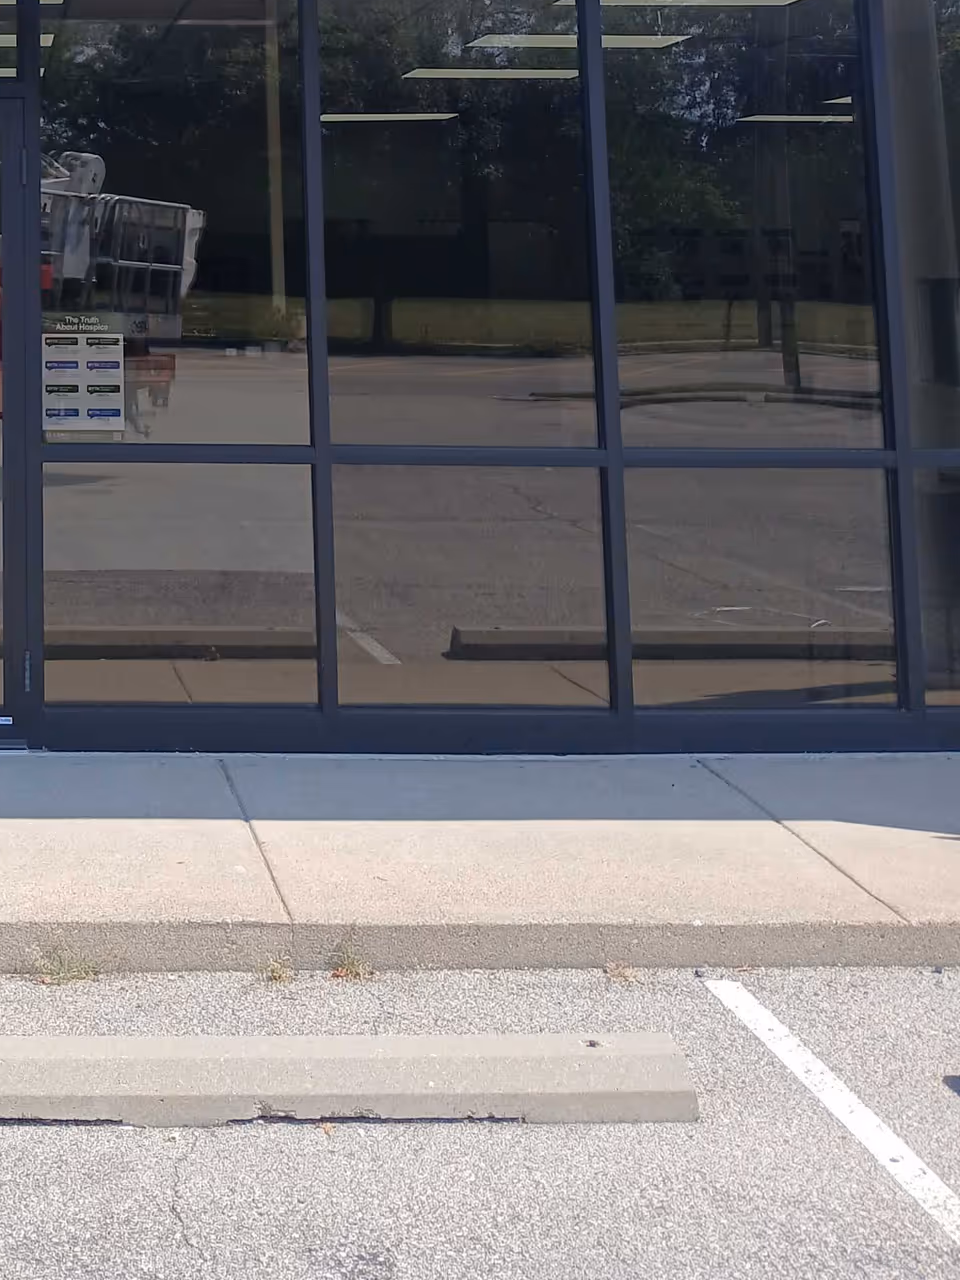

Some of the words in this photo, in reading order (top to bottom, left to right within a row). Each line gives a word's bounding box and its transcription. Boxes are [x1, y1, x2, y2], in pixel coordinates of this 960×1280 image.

[65, 315, 79, 323] The
[80, 315, 100, 324] Truth
[55, 322, 78, 331] About
[79, 322, 109, 332] Hospice
